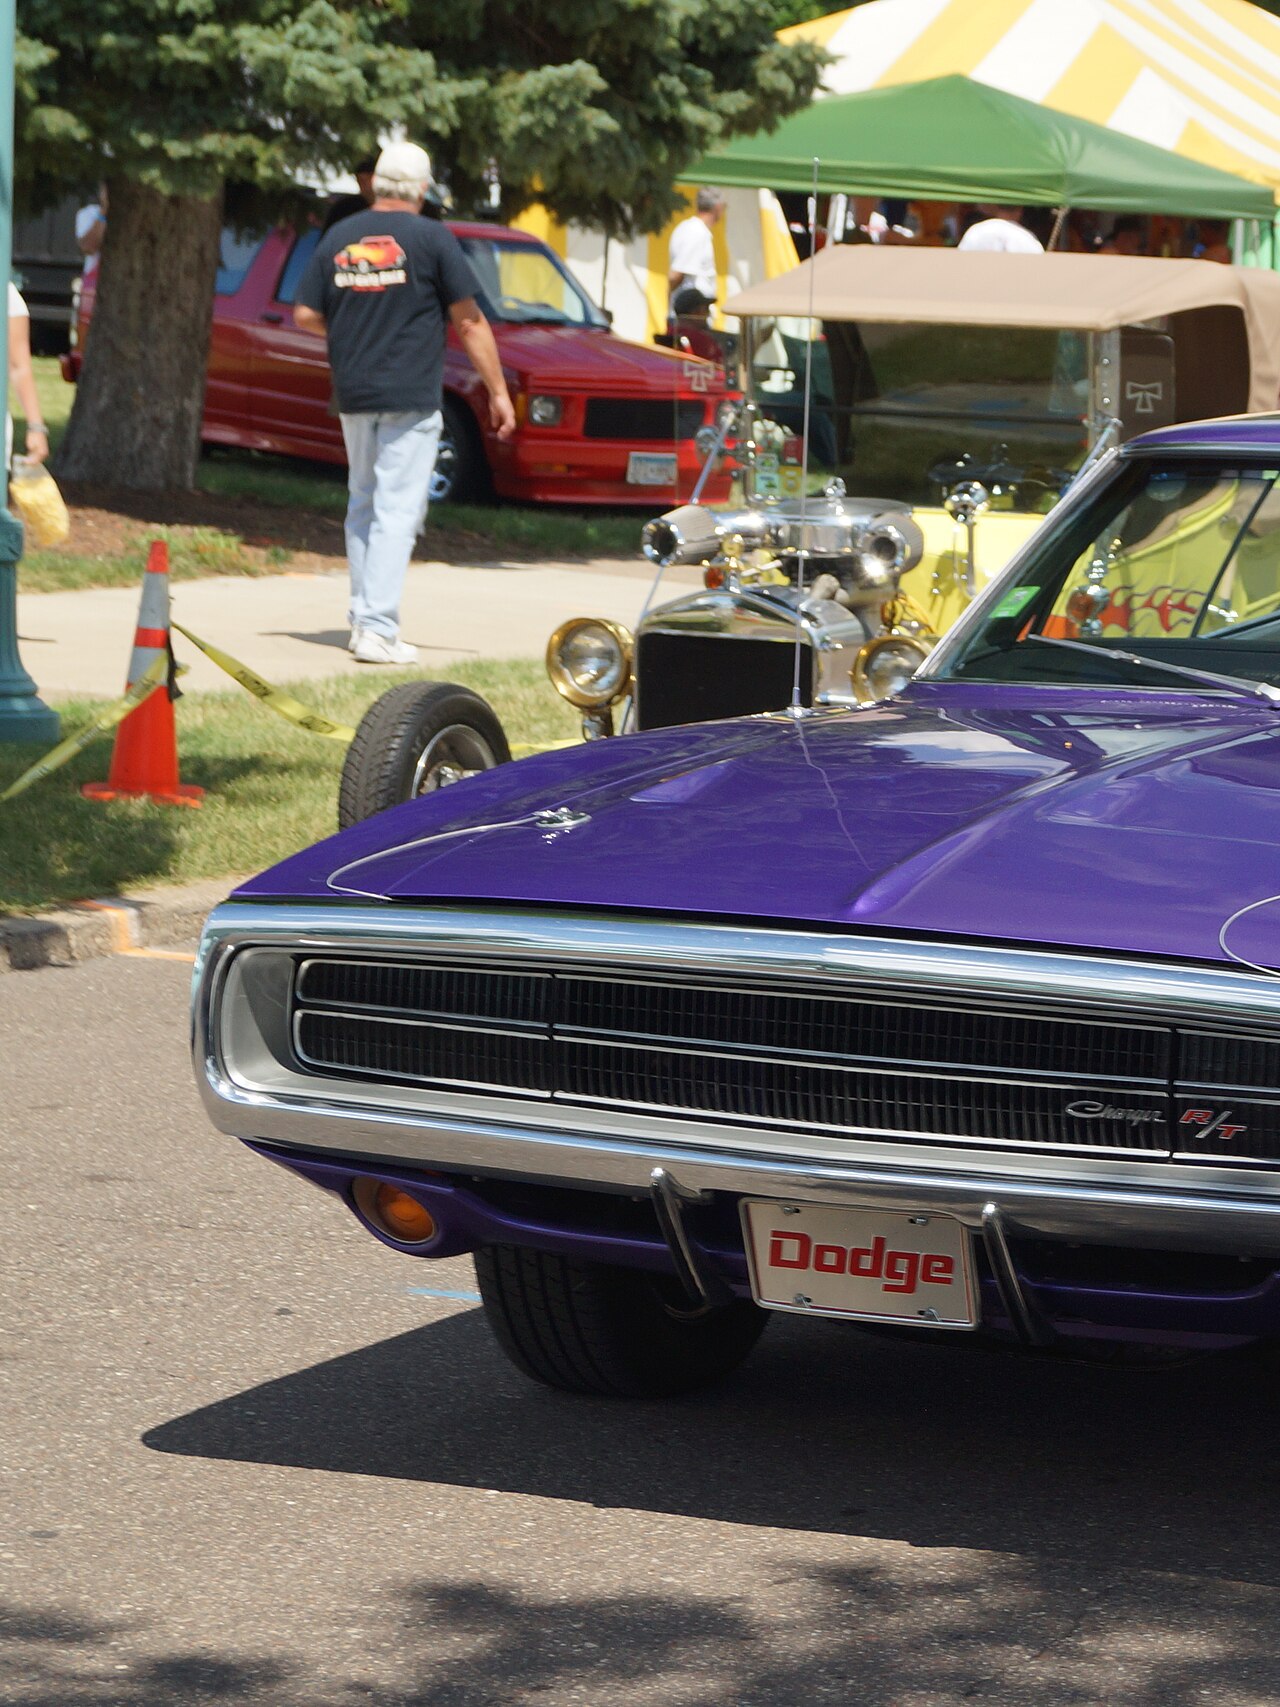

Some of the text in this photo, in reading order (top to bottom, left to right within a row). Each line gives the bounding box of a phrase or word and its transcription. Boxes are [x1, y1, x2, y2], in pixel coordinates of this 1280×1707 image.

[1065, 1100, 1247, 1140] Charger R/T
[768, 1229, 955, 1295] Dodge
